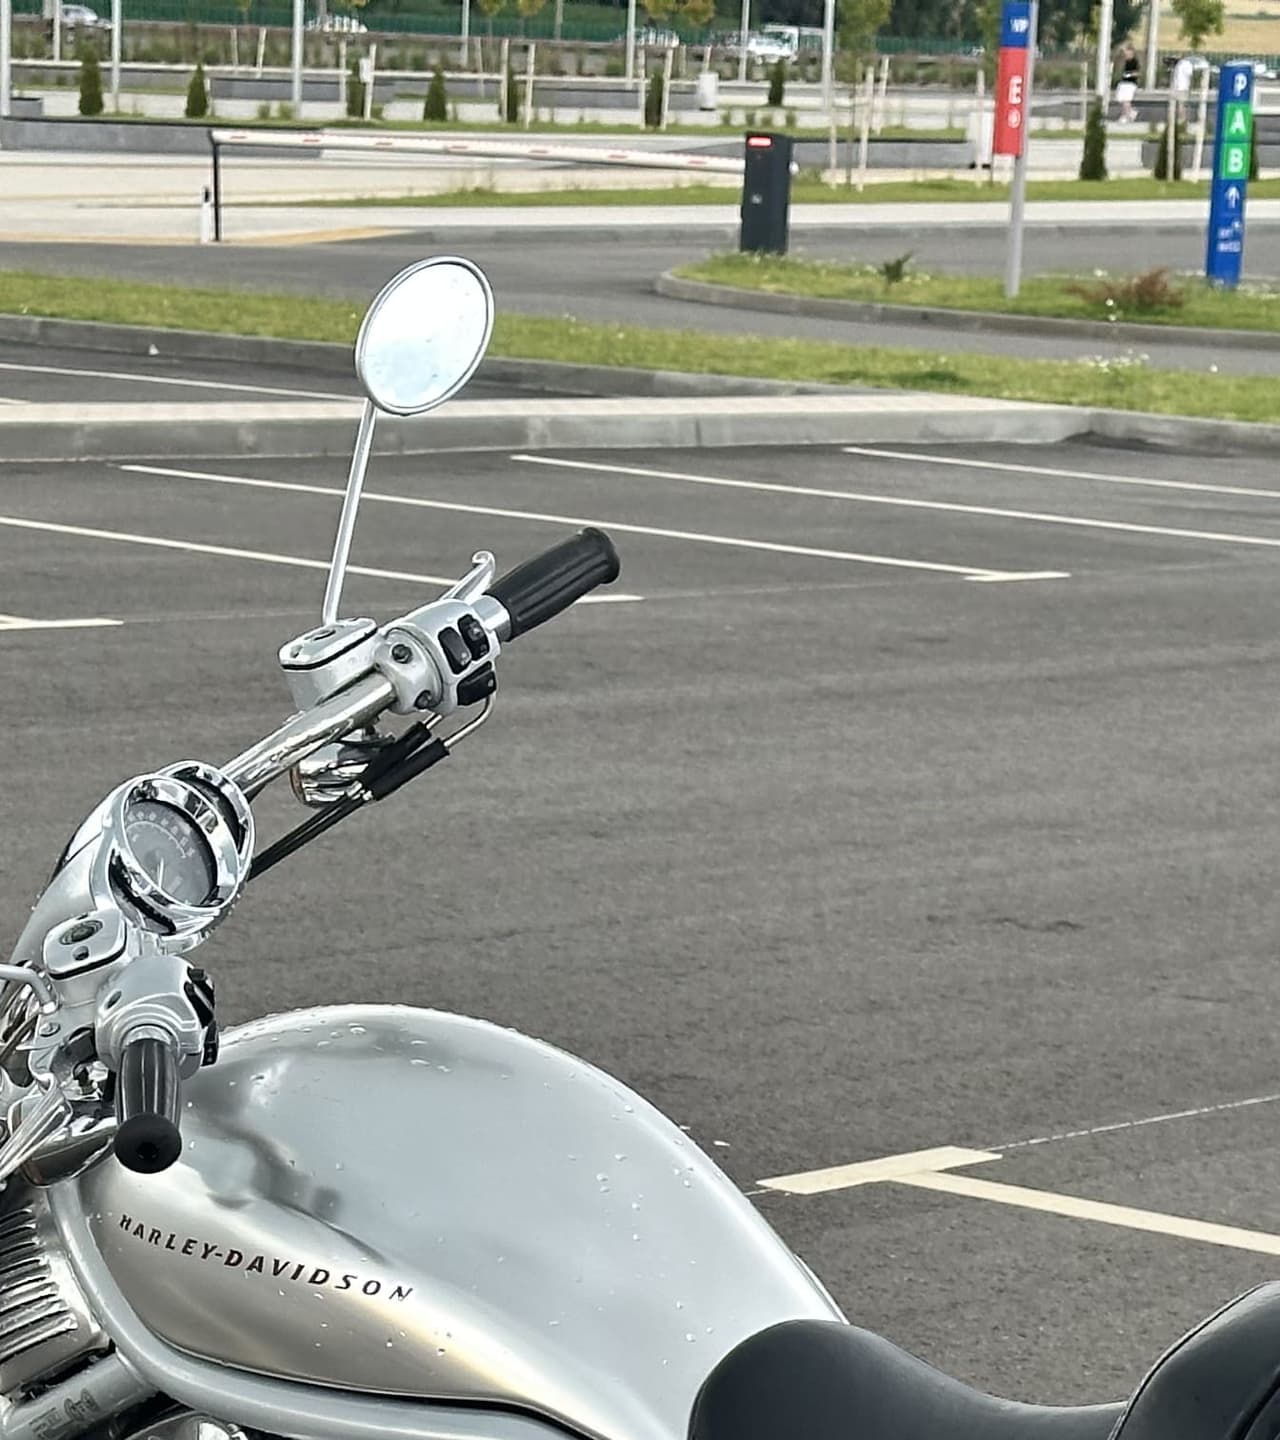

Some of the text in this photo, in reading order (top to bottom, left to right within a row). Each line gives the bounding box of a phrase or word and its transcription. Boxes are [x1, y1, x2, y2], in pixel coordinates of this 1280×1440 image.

[1008, 75, 1023, 105] E
[1232, 72, 1248, 97] P
[1229, 109, 1246, 134] A
[1227, 147, 1244, 173] B
[119, 1213, 414, 1301] HARLEY-DAVIDSON
